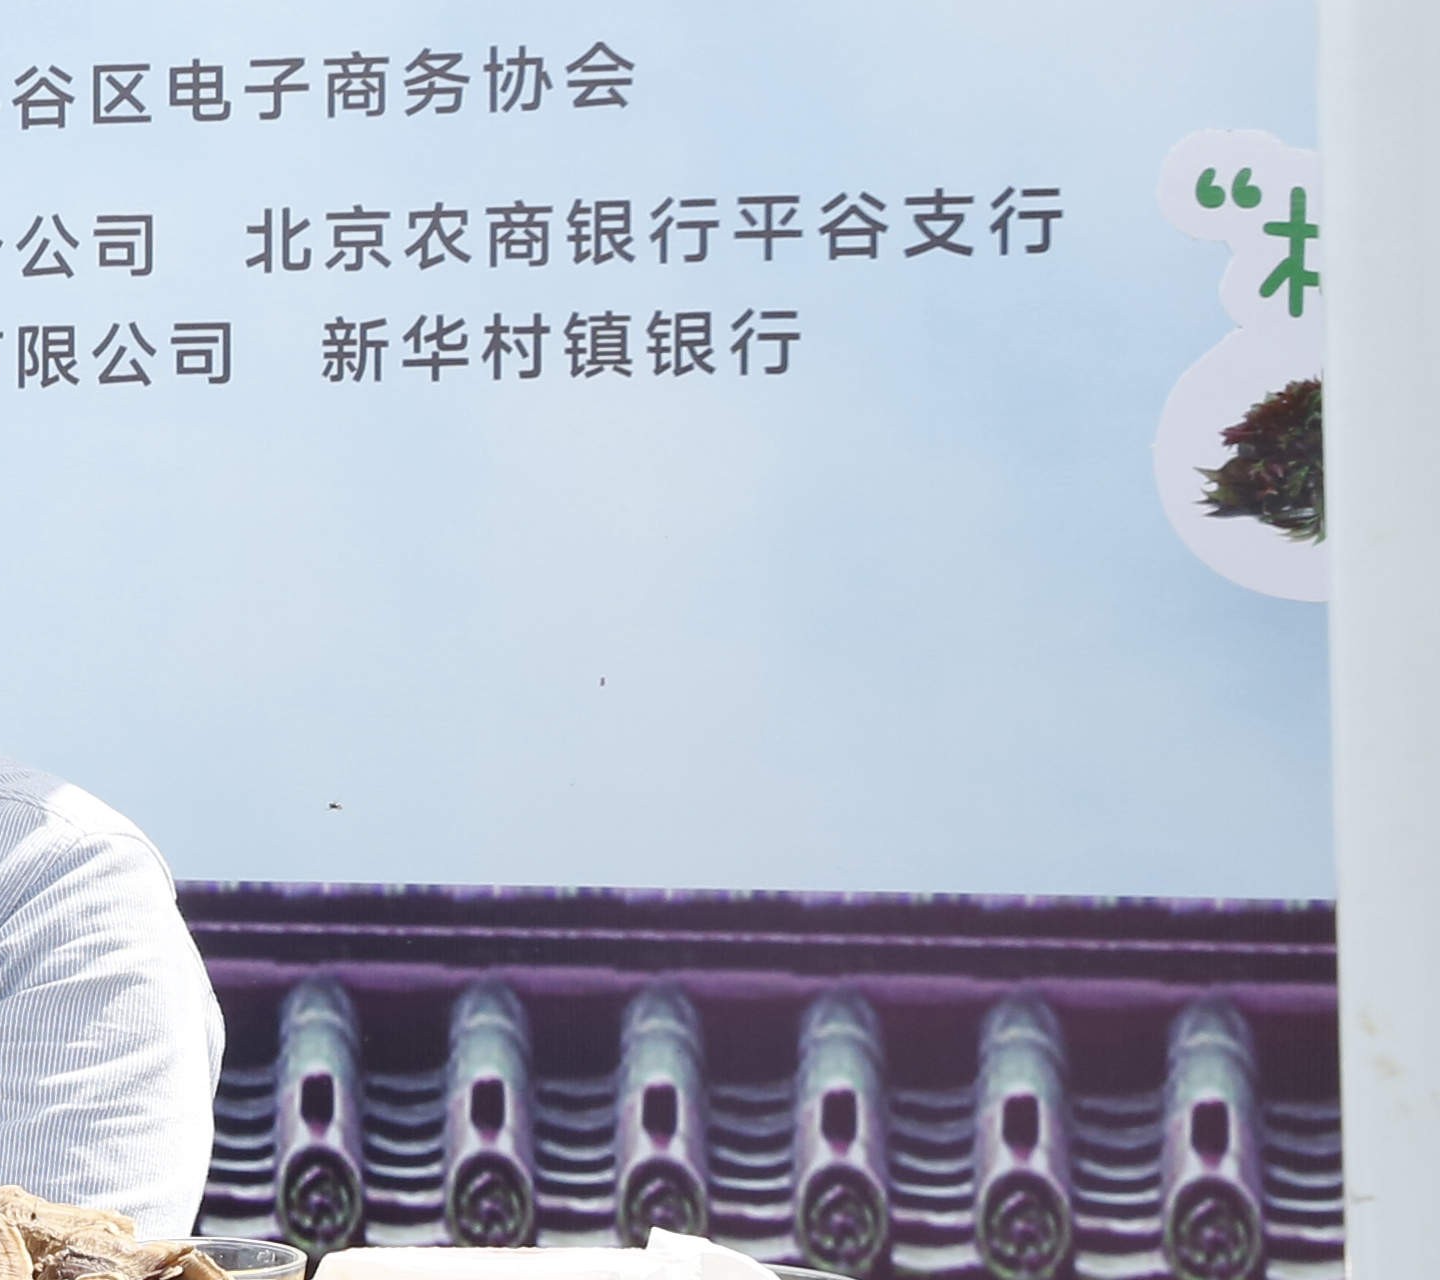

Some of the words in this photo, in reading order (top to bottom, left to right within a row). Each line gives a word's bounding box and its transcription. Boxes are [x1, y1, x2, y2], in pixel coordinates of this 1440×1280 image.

[244, 185, 1064, 275] 北京农商银行平谷支行
[321, 307, 802, 384] 新华村镇银行
